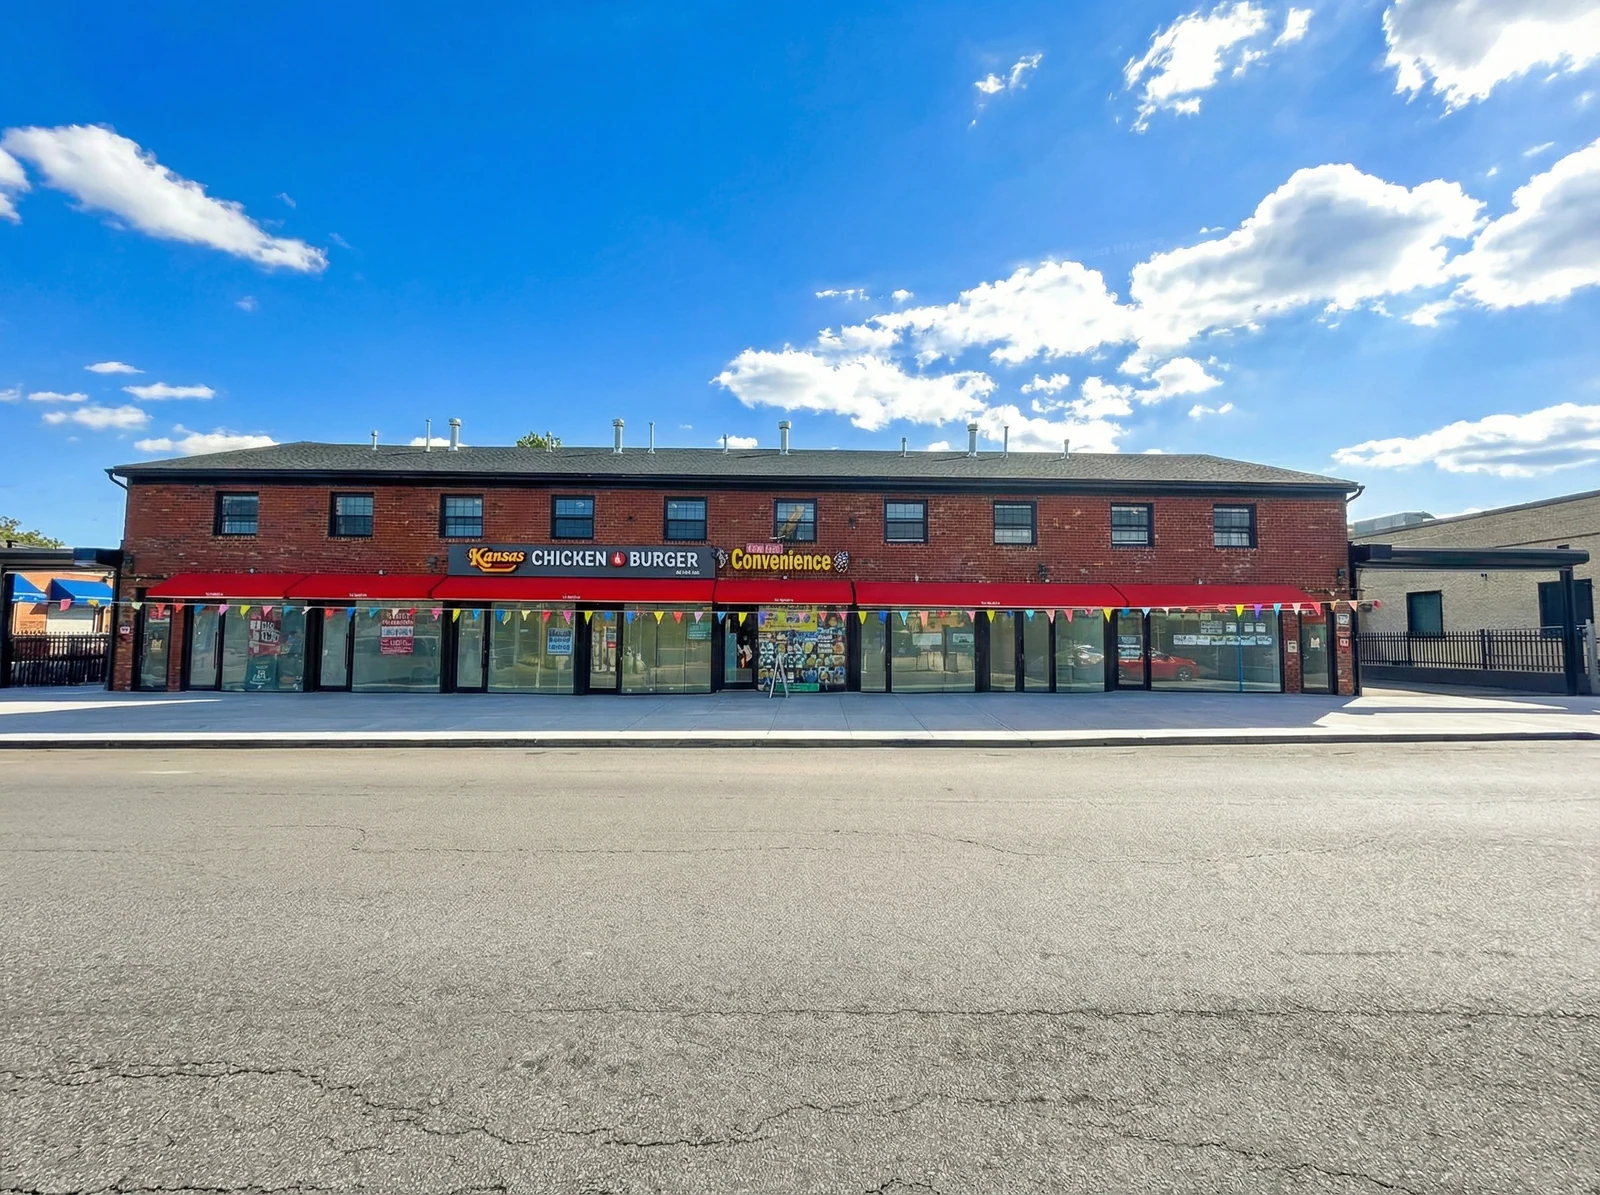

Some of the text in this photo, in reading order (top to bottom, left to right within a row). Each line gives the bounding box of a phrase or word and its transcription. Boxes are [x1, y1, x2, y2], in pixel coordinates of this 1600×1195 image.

[469, 547, 699, 568] Kansas CHICKEN BURGER
[731, 548, 832, 571] Convenience
